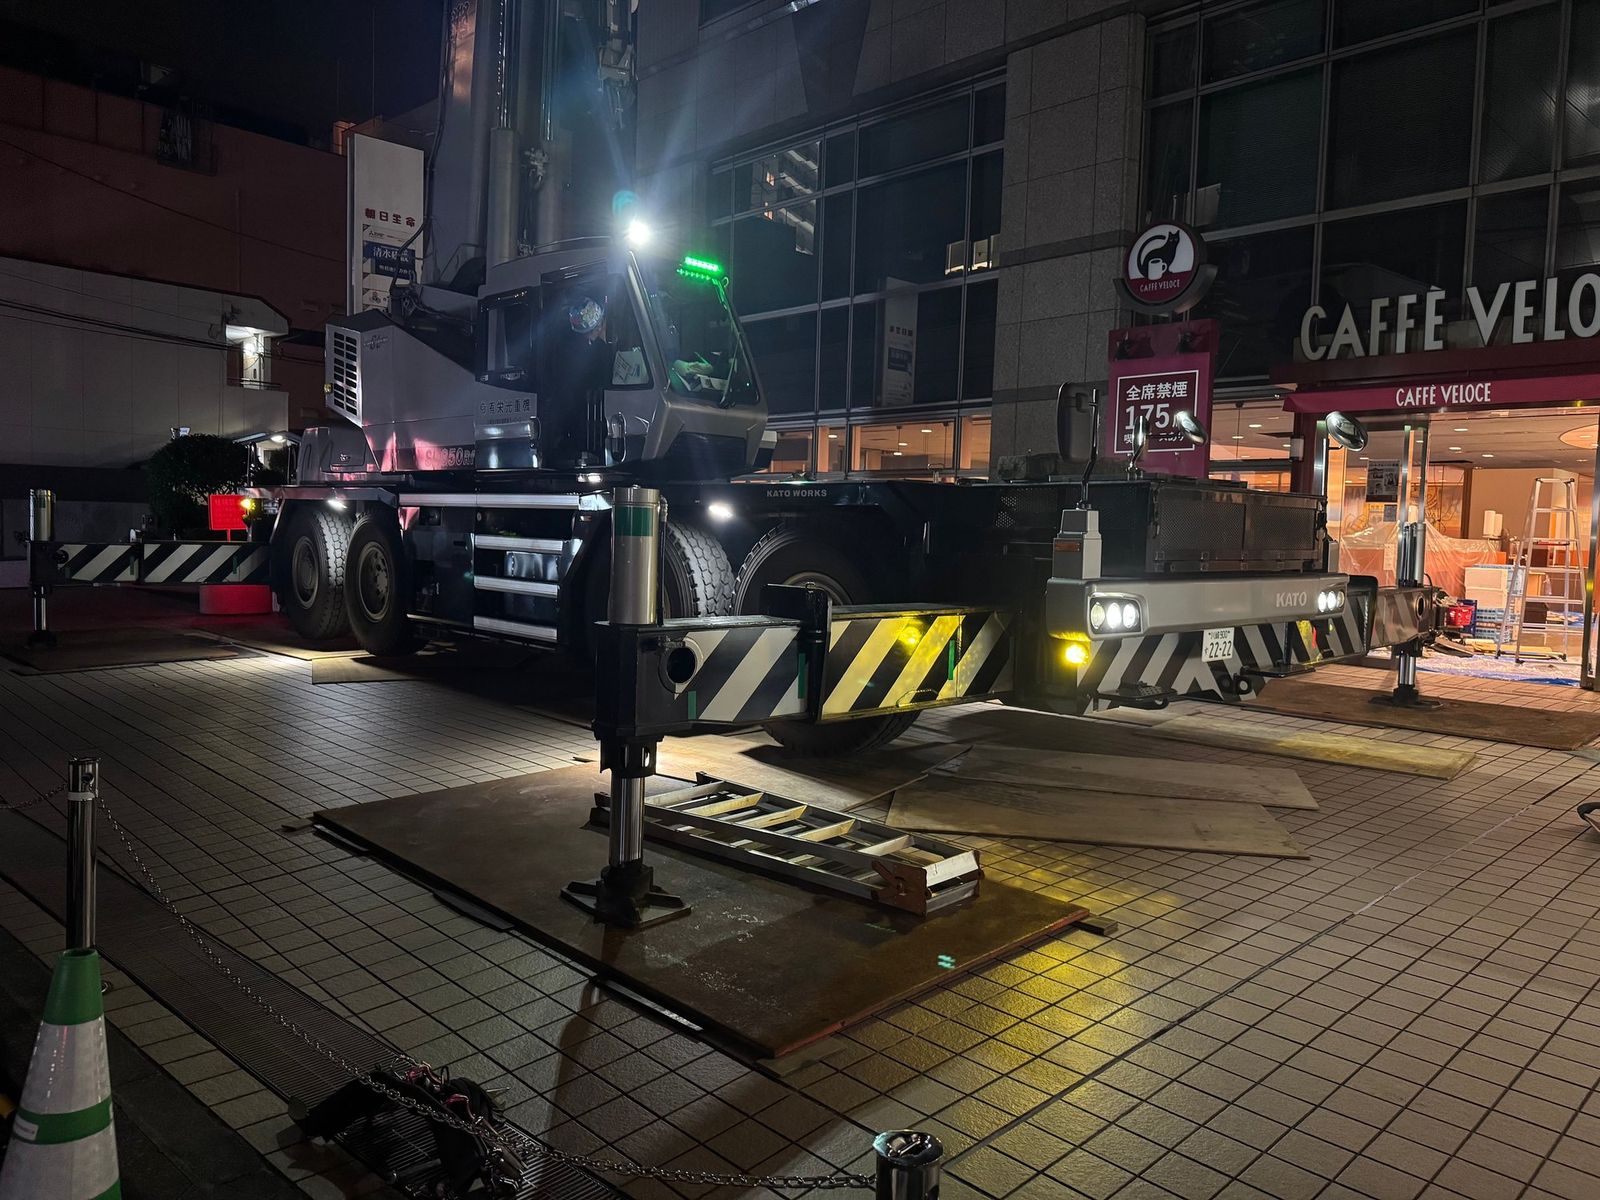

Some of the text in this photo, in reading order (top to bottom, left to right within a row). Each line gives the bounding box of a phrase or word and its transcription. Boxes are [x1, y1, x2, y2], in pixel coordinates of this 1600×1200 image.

[364, 208, 416, 228] 朝日生命
[1159, 279, 1181, 290] VELOCE
[1300, 272, 1600, 361] CAFFÈ VELO
[1126, 381, 1188, 401] 全席禁煙
[1395, 381, 1492, 408] CAFFÈ VELOCE
[766, 489, 827, 498] KATO WORKS
[1276, 592, 1308, 607] KATO
